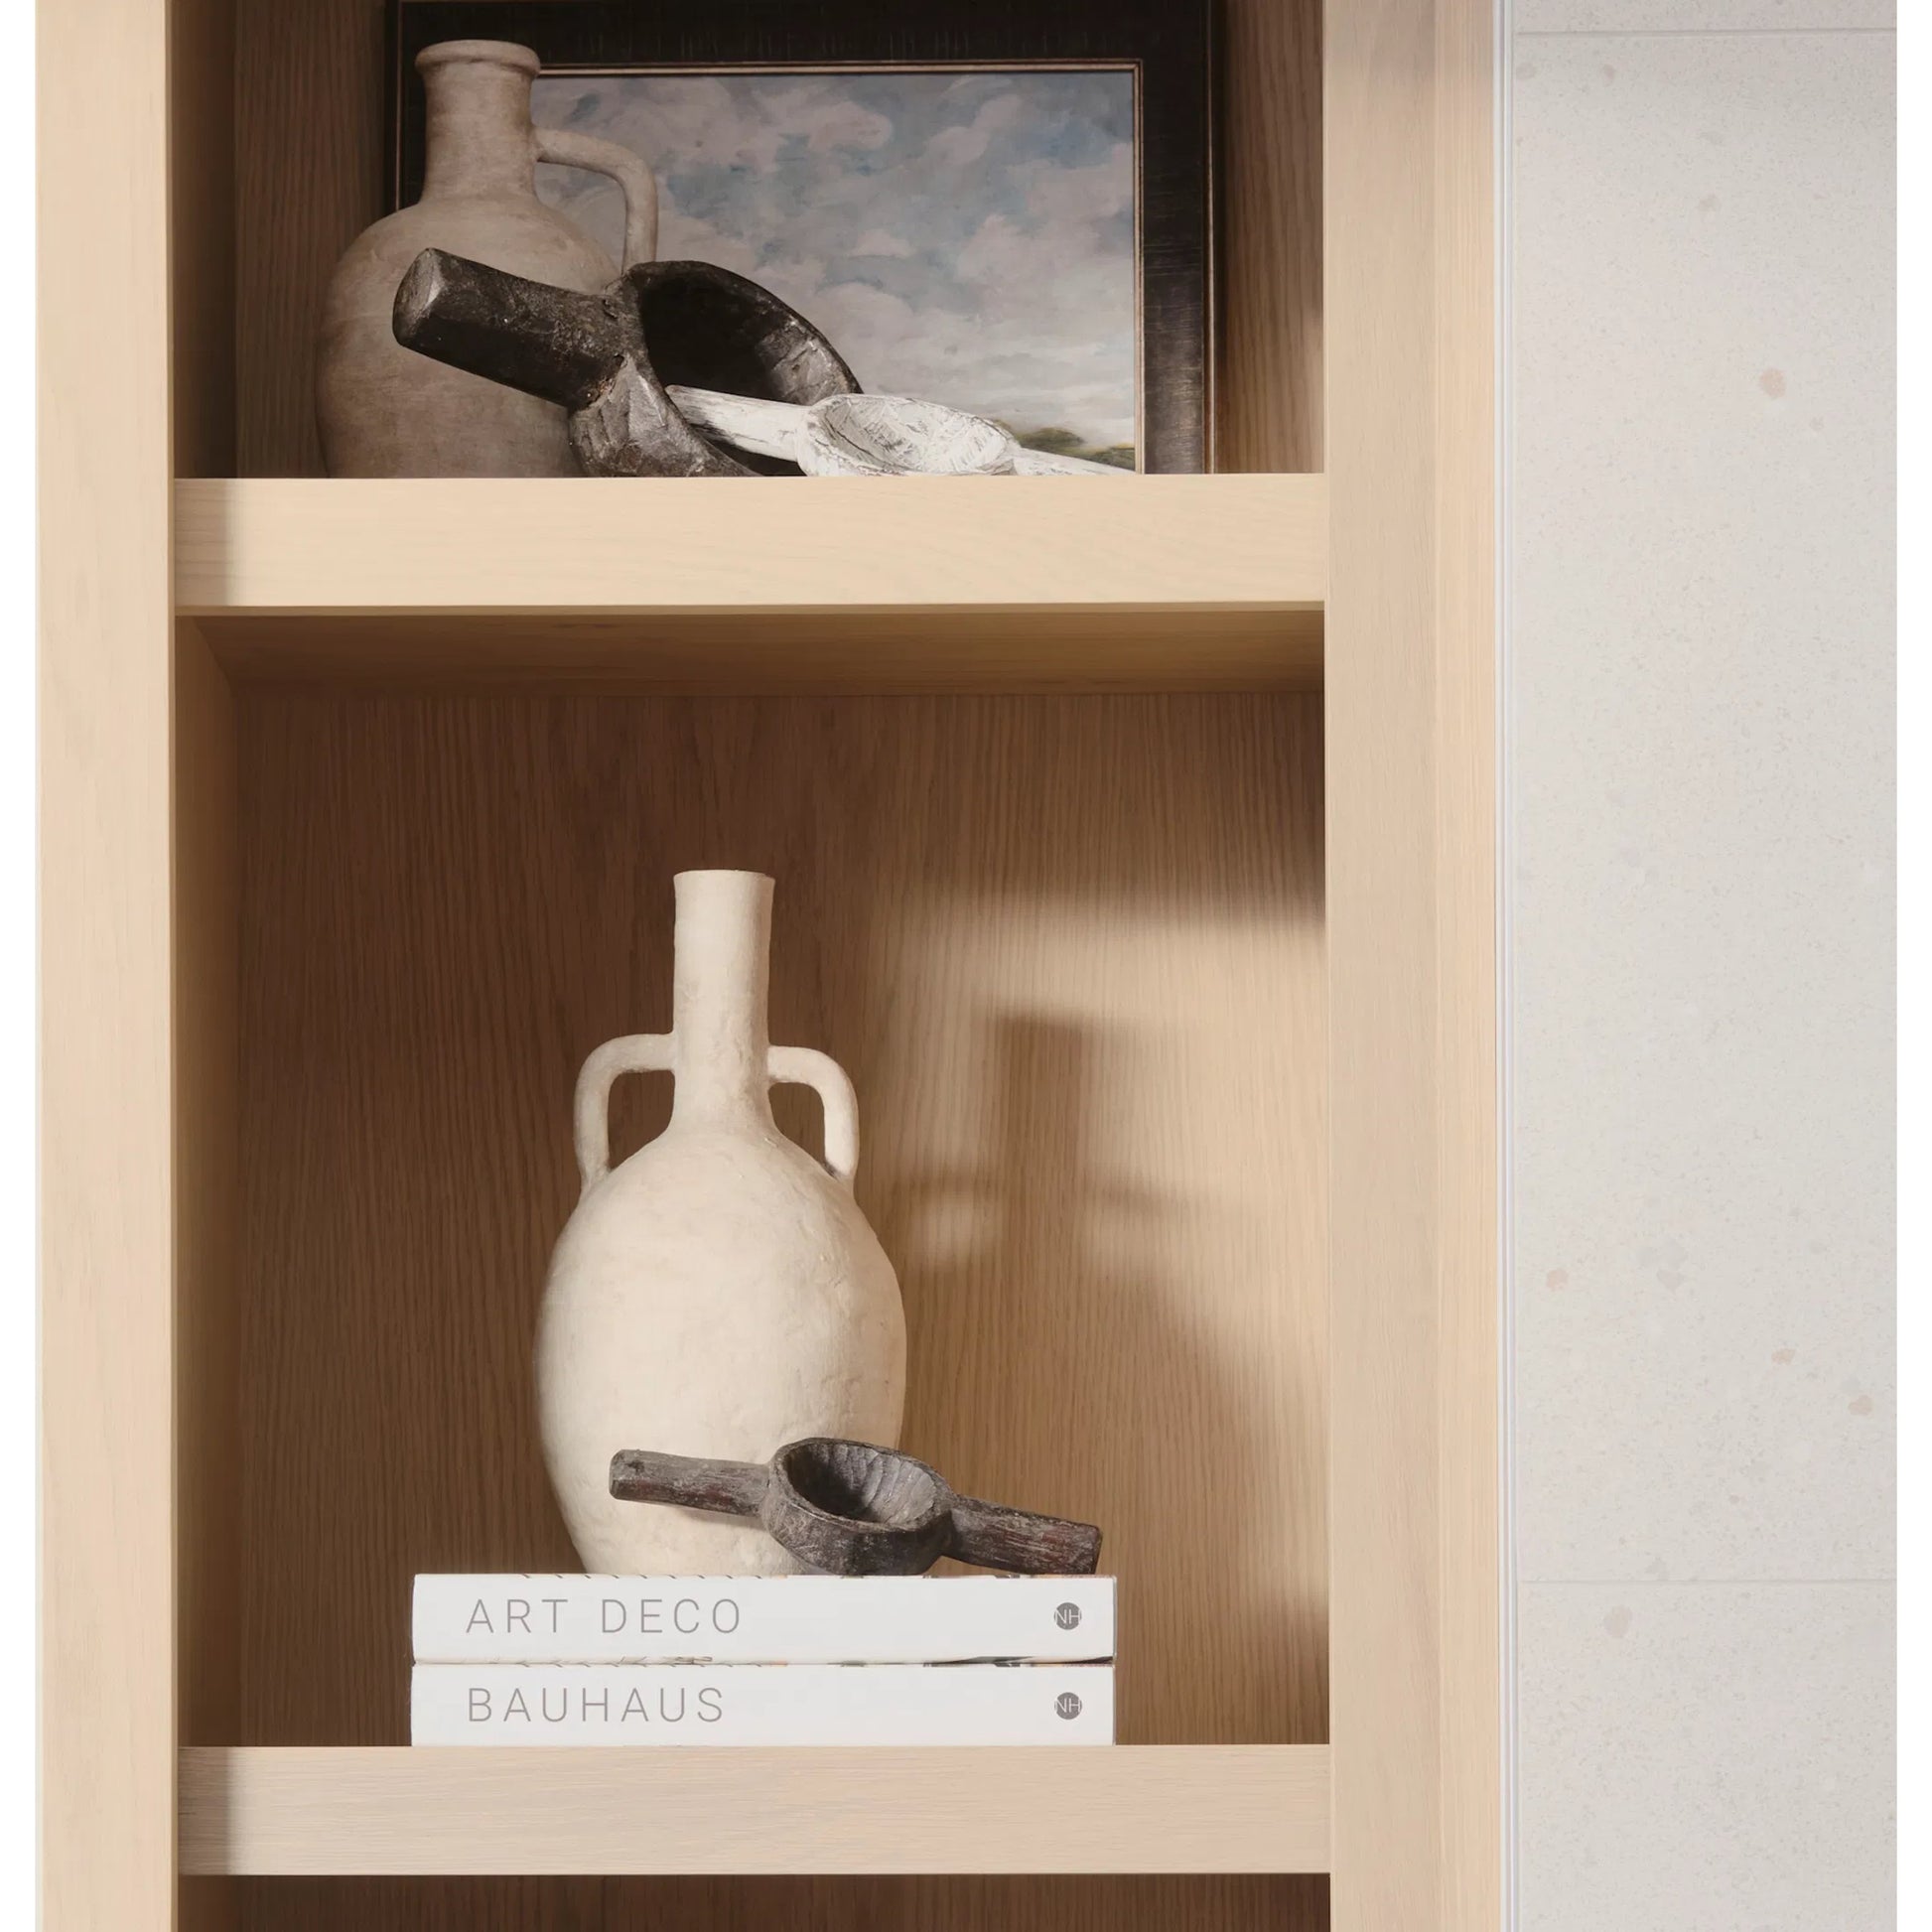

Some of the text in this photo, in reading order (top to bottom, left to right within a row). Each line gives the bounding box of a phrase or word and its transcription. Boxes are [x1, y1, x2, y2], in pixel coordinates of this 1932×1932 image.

[466, 1598, 740, 1634] ART DECO
[1053, 1607, 1082, 1625] NH
[468, 1688, 723, 1723] BAUHAUS
[1053, 1697, 1082, 1715] NH
